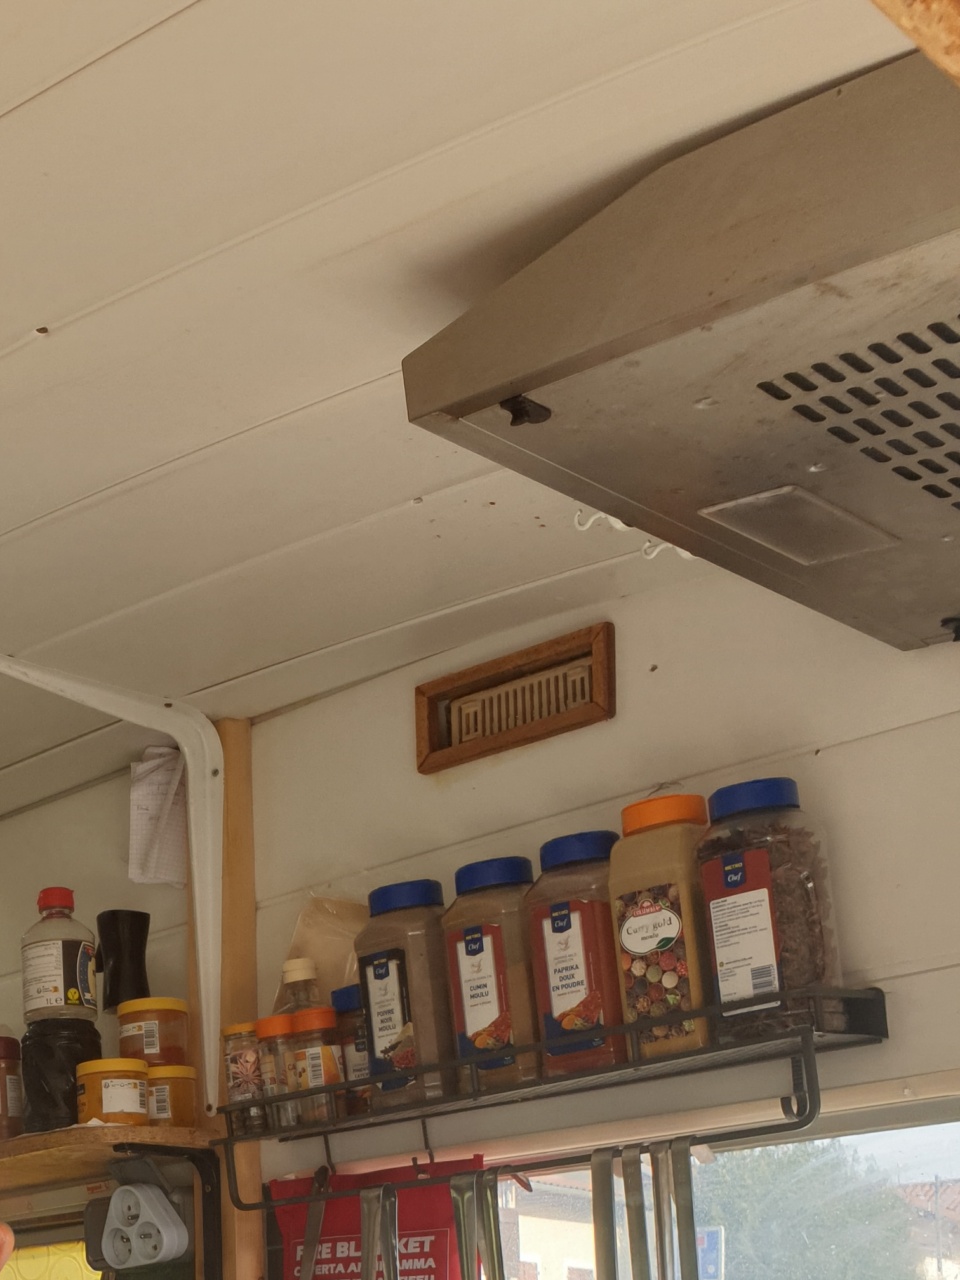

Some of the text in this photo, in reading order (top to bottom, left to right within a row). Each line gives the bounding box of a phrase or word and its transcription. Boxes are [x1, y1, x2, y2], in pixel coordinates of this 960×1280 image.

[652, 916, 673, 932] gold
[553, 964, 579, 975] PAPRIKA
[559, 973, 575, 982] DOUX
[469, 983, 488, 992] CUMIN
[552, 980, 585, 993] EN POUDRE
[469, 991, 489, 1000] MOULU
[376, 1008, 395, 1017] POIVRE
[378, 1024, 397, 1033] MOULU
[296, 1236, 435, 1261] FRE BLKET
